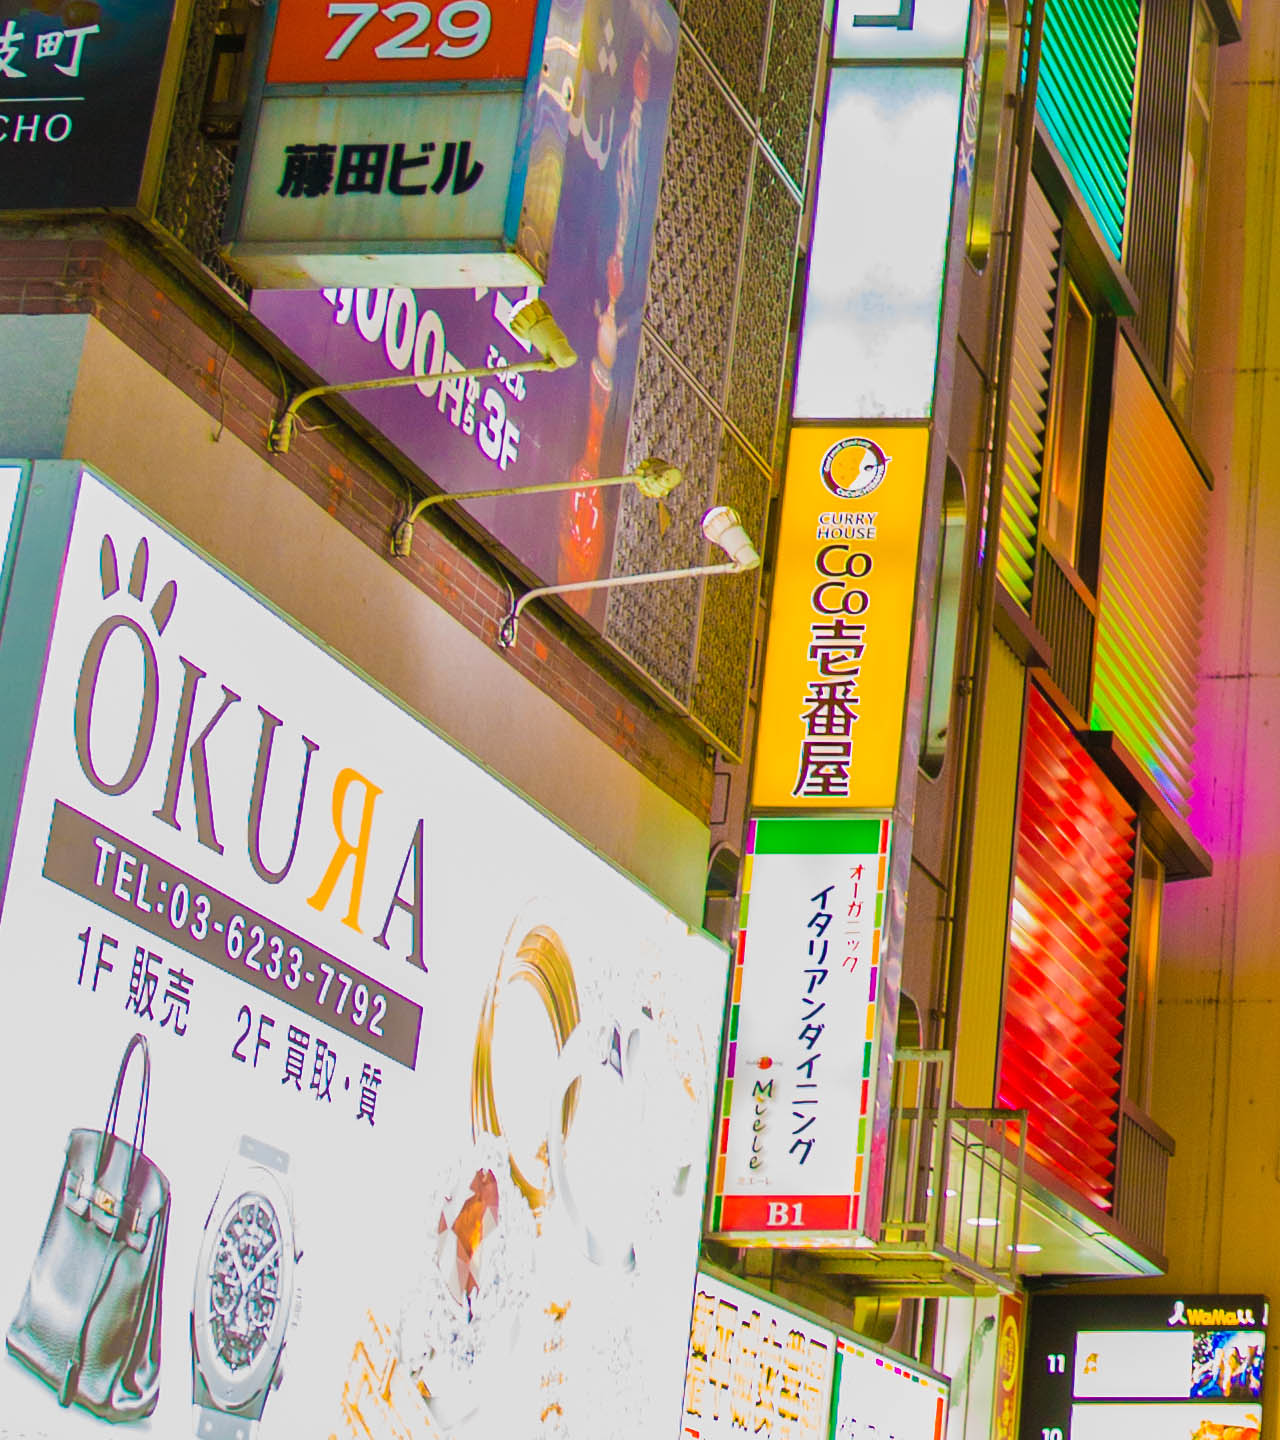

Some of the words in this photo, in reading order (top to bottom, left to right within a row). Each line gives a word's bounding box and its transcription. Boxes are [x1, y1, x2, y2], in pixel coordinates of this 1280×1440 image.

[324, 0, 493, 61] 729
[277, 140, 484, 199] 藤田ビル
[815, 525, 877, 541] HOUSE
[817, 511, 879, 527] CURRY
[842, 863, 867, 974] オーガニック
[77, 926, 120, 994] 1F
[128, 944, 195, 1036] 販売
[231, 1005, 276, 1070] 2F
[789, 884, 836, 1166] イタリアンダイニング
[766, 1201, 805, 1228] B1
[1046, 1354, 1067, 1374] 11
